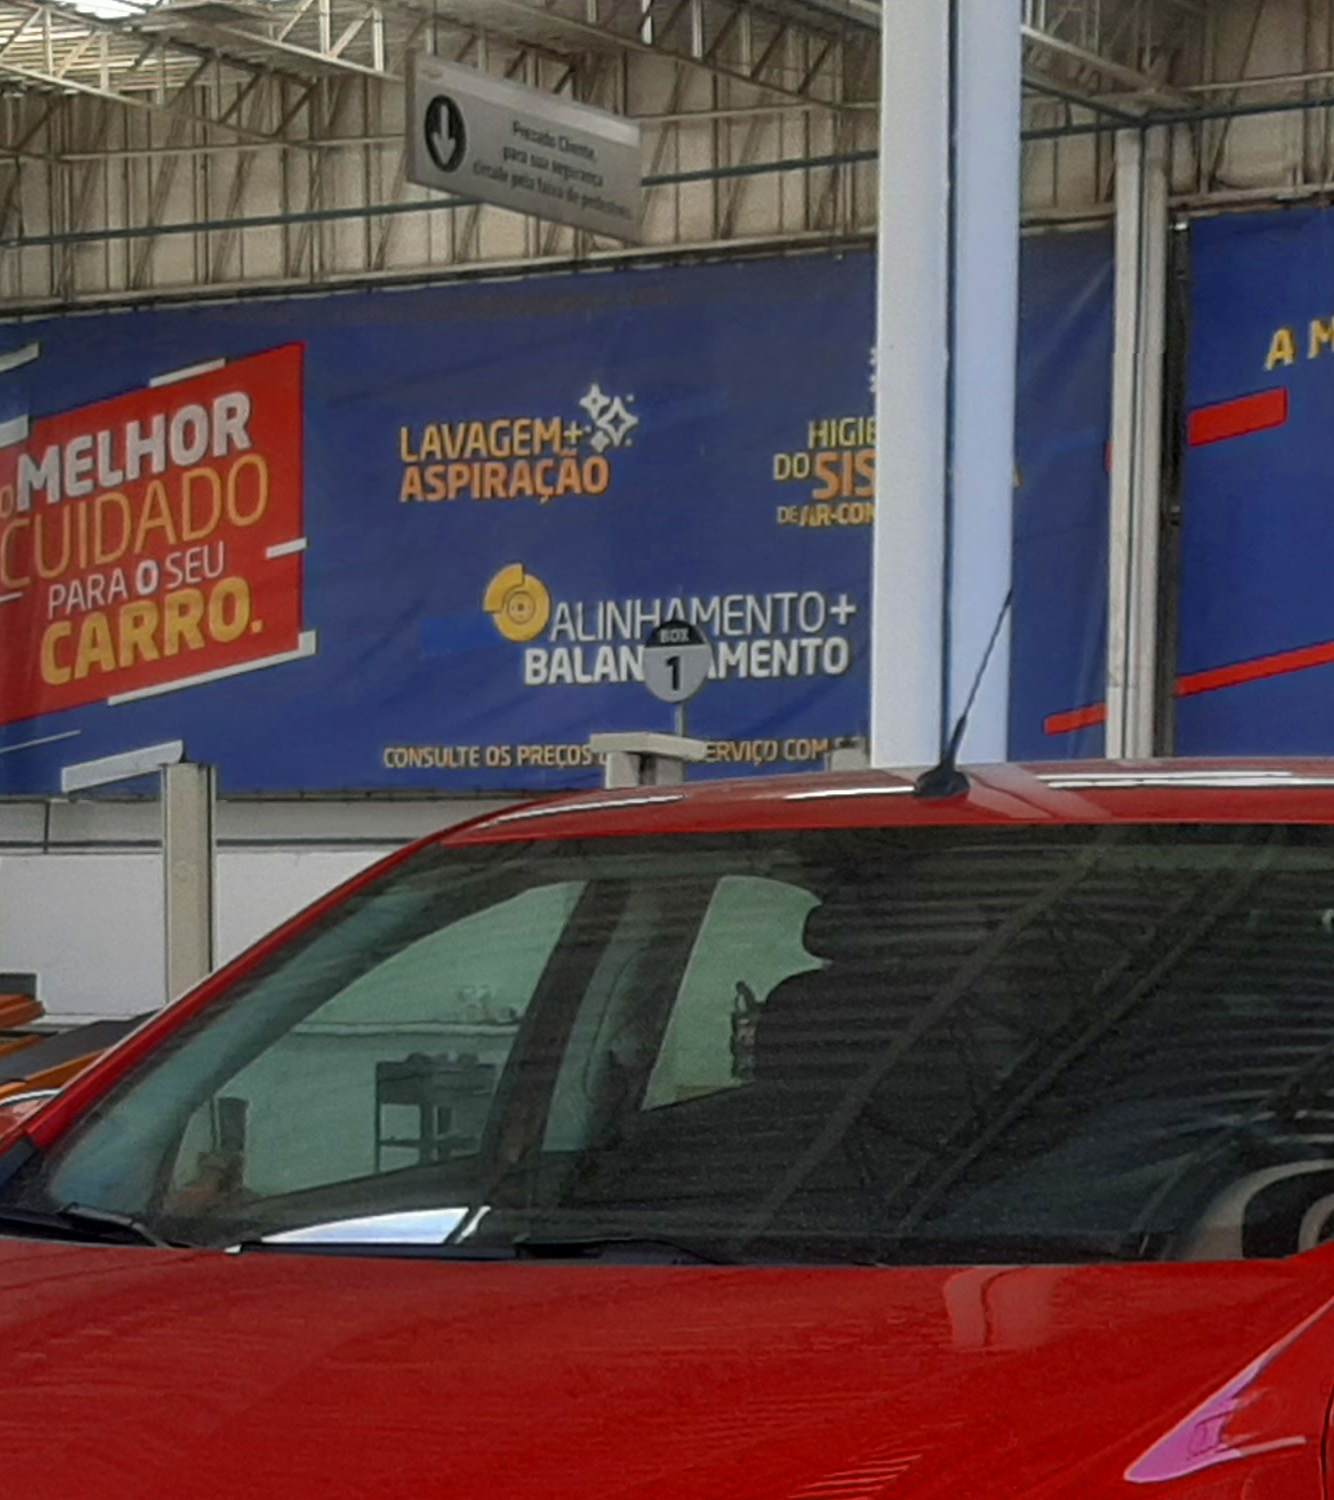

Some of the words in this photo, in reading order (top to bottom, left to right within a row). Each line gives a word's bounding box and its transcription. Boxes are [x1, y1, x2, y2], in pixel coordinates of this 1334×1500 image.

[1265, 325, 1295, 370] A
[17, 391, 252, 512] MELHOR
[807, 417, 876, 448] HIGIE
[399, 448, 609, 505] ASPIRAÇÃO
[773, 453, 809, 480] DO
[812, 449, 877, 500] SIS
[0, 453, 269, 590] CUIDADO
[777, 506, 798, 523] DE
[48, 570, 128, 619] PARA
[136, 561, 158, 595] O
[166, 541, 225, 586] SEU
[40, 577, 263, 685] CARRO.
[660, 629, 689, 643] BOX
[525, 638, 849, 685] BALANMENTO
[666, 655, 680, 691] 1
[383, 746, 480, 769] CONSULTE
[486, 745, 511, 766] OS
[516, 743, 592, 769] PREÇOS
[704, 740, 778, 766] ERVIÇO
[784, 738, 828, 760] COM
